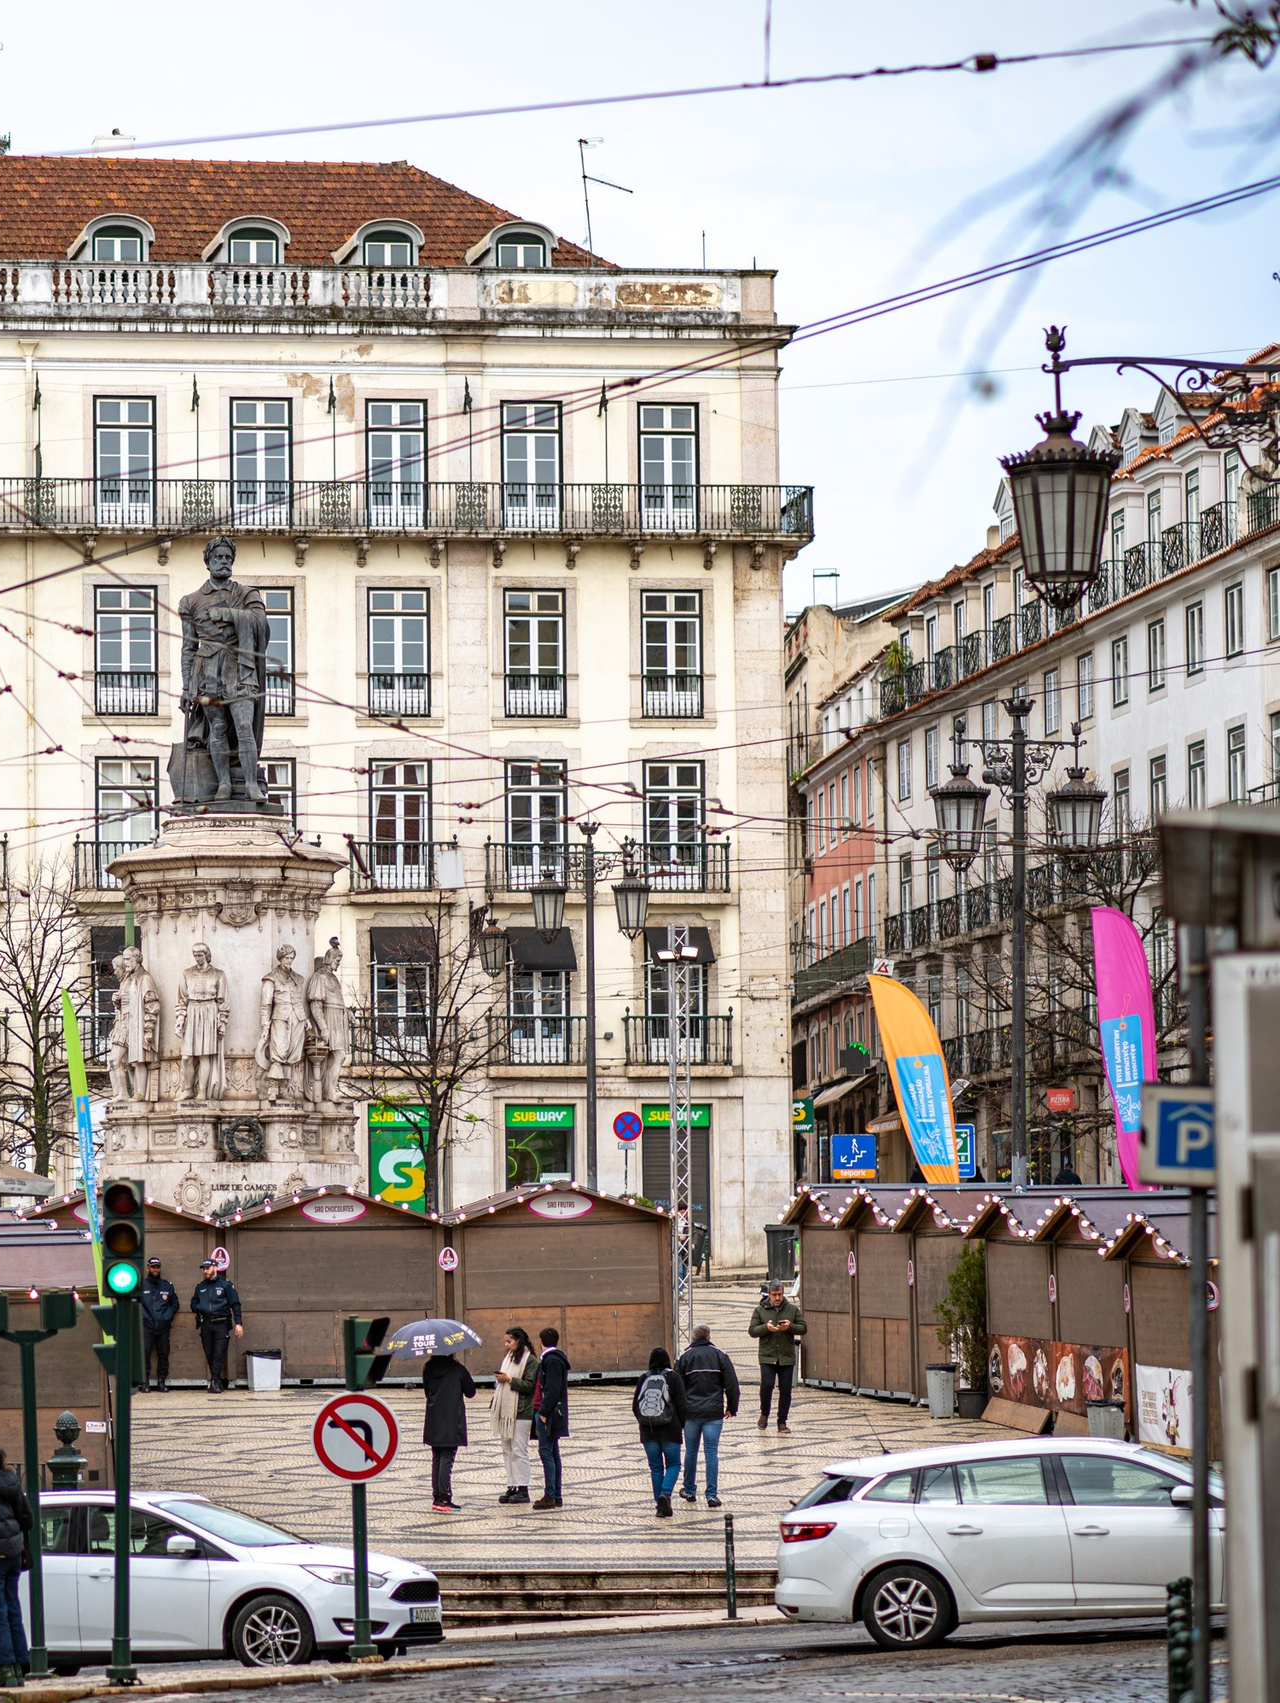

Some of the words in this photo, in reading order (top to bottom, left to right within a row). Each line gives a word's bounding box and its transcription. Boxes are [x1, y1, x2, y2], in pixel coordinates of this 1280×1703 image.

[370, 1111, 425, 1122] SUBWAY
[512, 1111, 567, 1122] SUBWAY
[1176, 1120, 1212, 1164] P
[840, 1169, 866, 1177] telpark
[324, 1205, 354, 1213] CHOCOLATES
[413, 1334, 435, 1342] FREE
